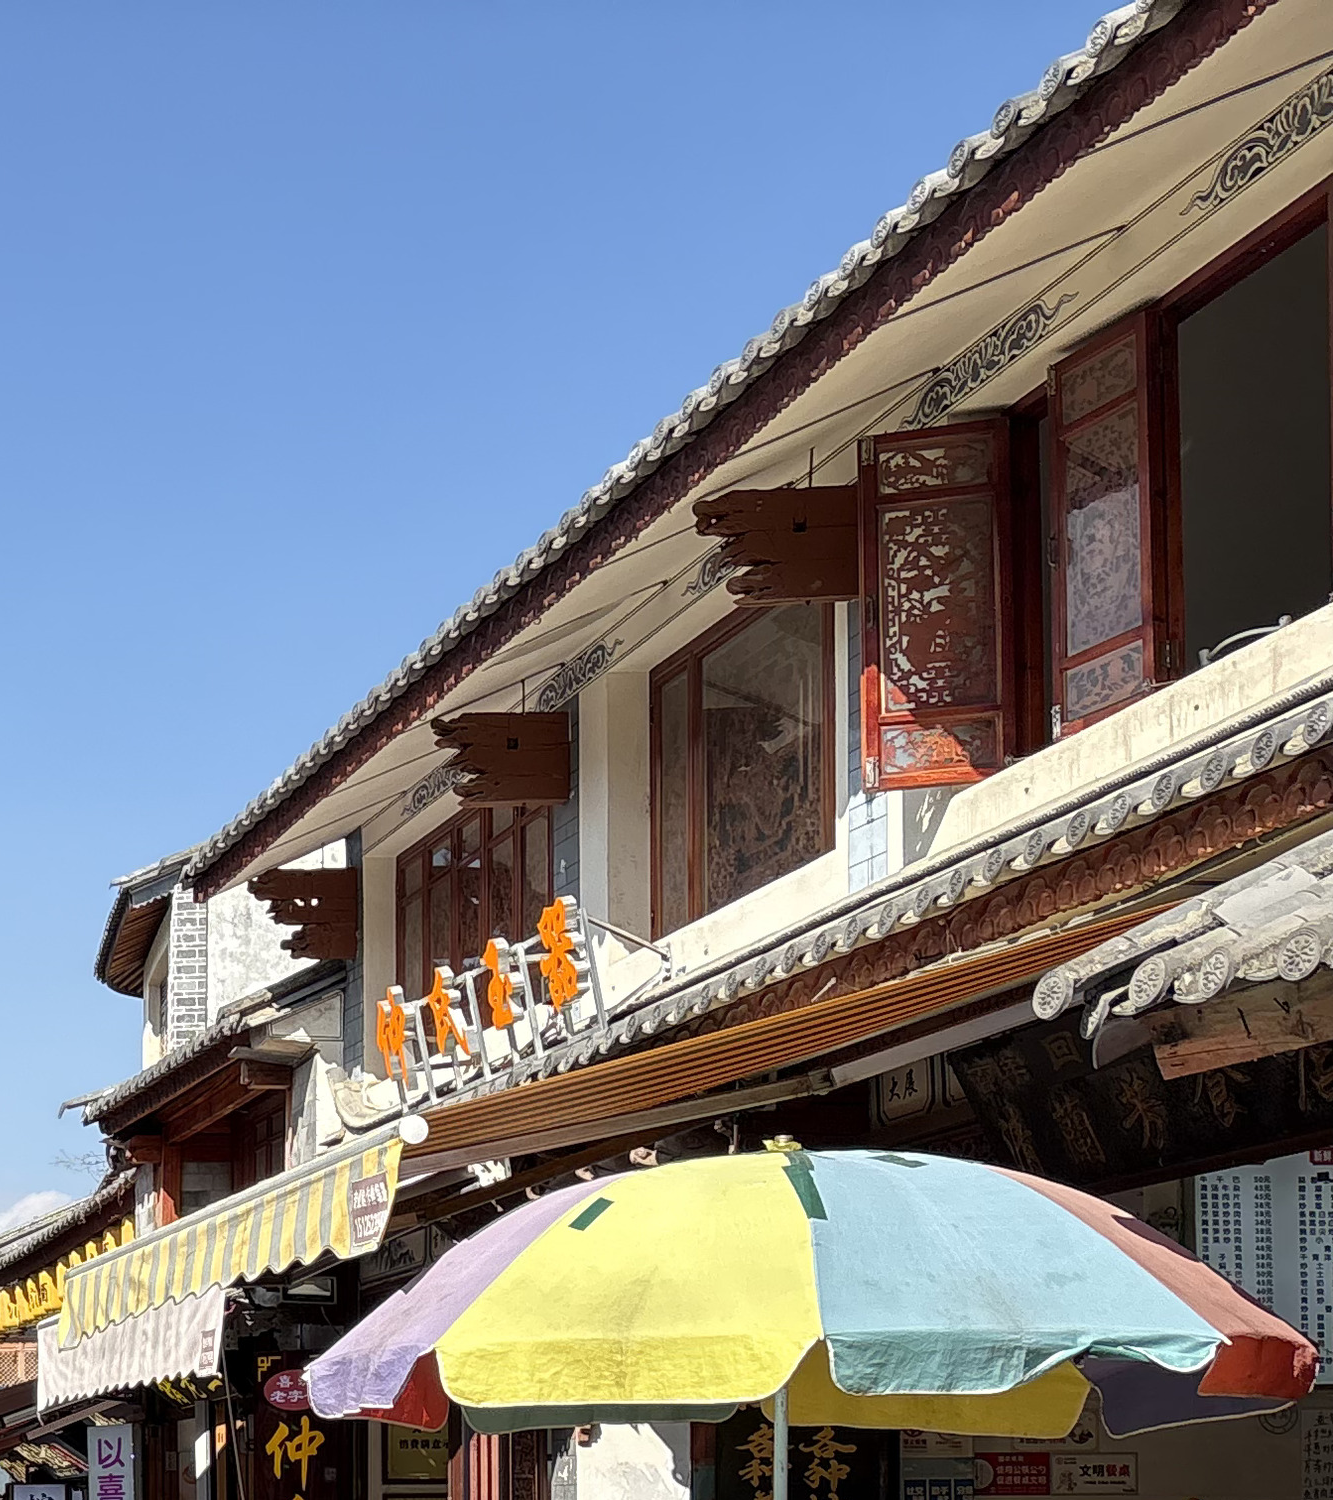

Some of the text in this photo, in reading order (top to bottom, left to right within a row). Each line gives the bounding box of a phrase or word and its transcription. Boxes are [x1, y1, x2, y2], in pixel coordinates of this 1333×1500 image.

[377, 896, 579, 1088] 仲氏玉器
[270, 1390, 308, 1403] 老字
[1079, 1464, 1130, 1478] 文明餐桌
